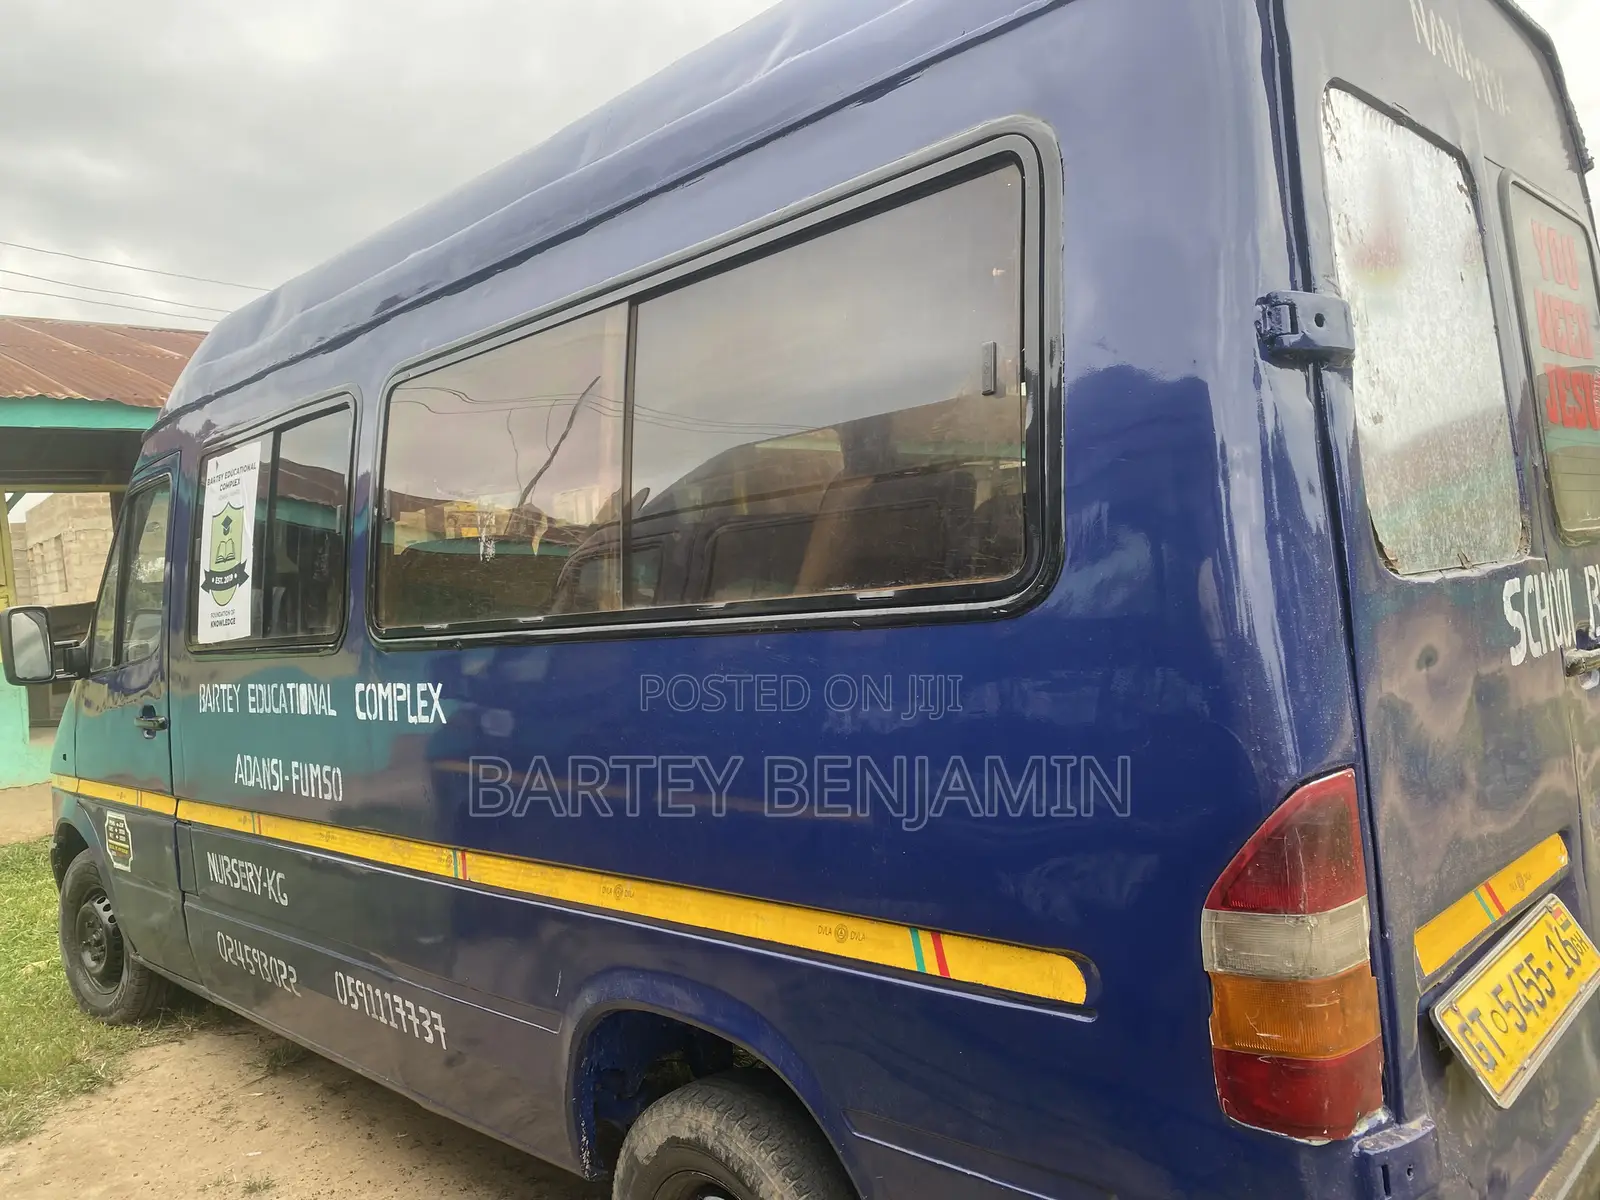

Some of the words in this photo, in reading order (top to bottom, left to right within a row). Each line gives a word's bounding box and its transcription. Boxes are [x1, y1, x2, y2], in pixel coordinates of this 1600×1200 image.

[1531, 218, 1578, 291] YOU
[199, 683, 241, 713] BARTEY
[248, 683, 337, 716] EDUCATIONAL
[355, 682, 447, 724] COMPLEX
[334, 971, 447, 1050] 0591117737
[1457, 1007, 1507, 1073] GT
